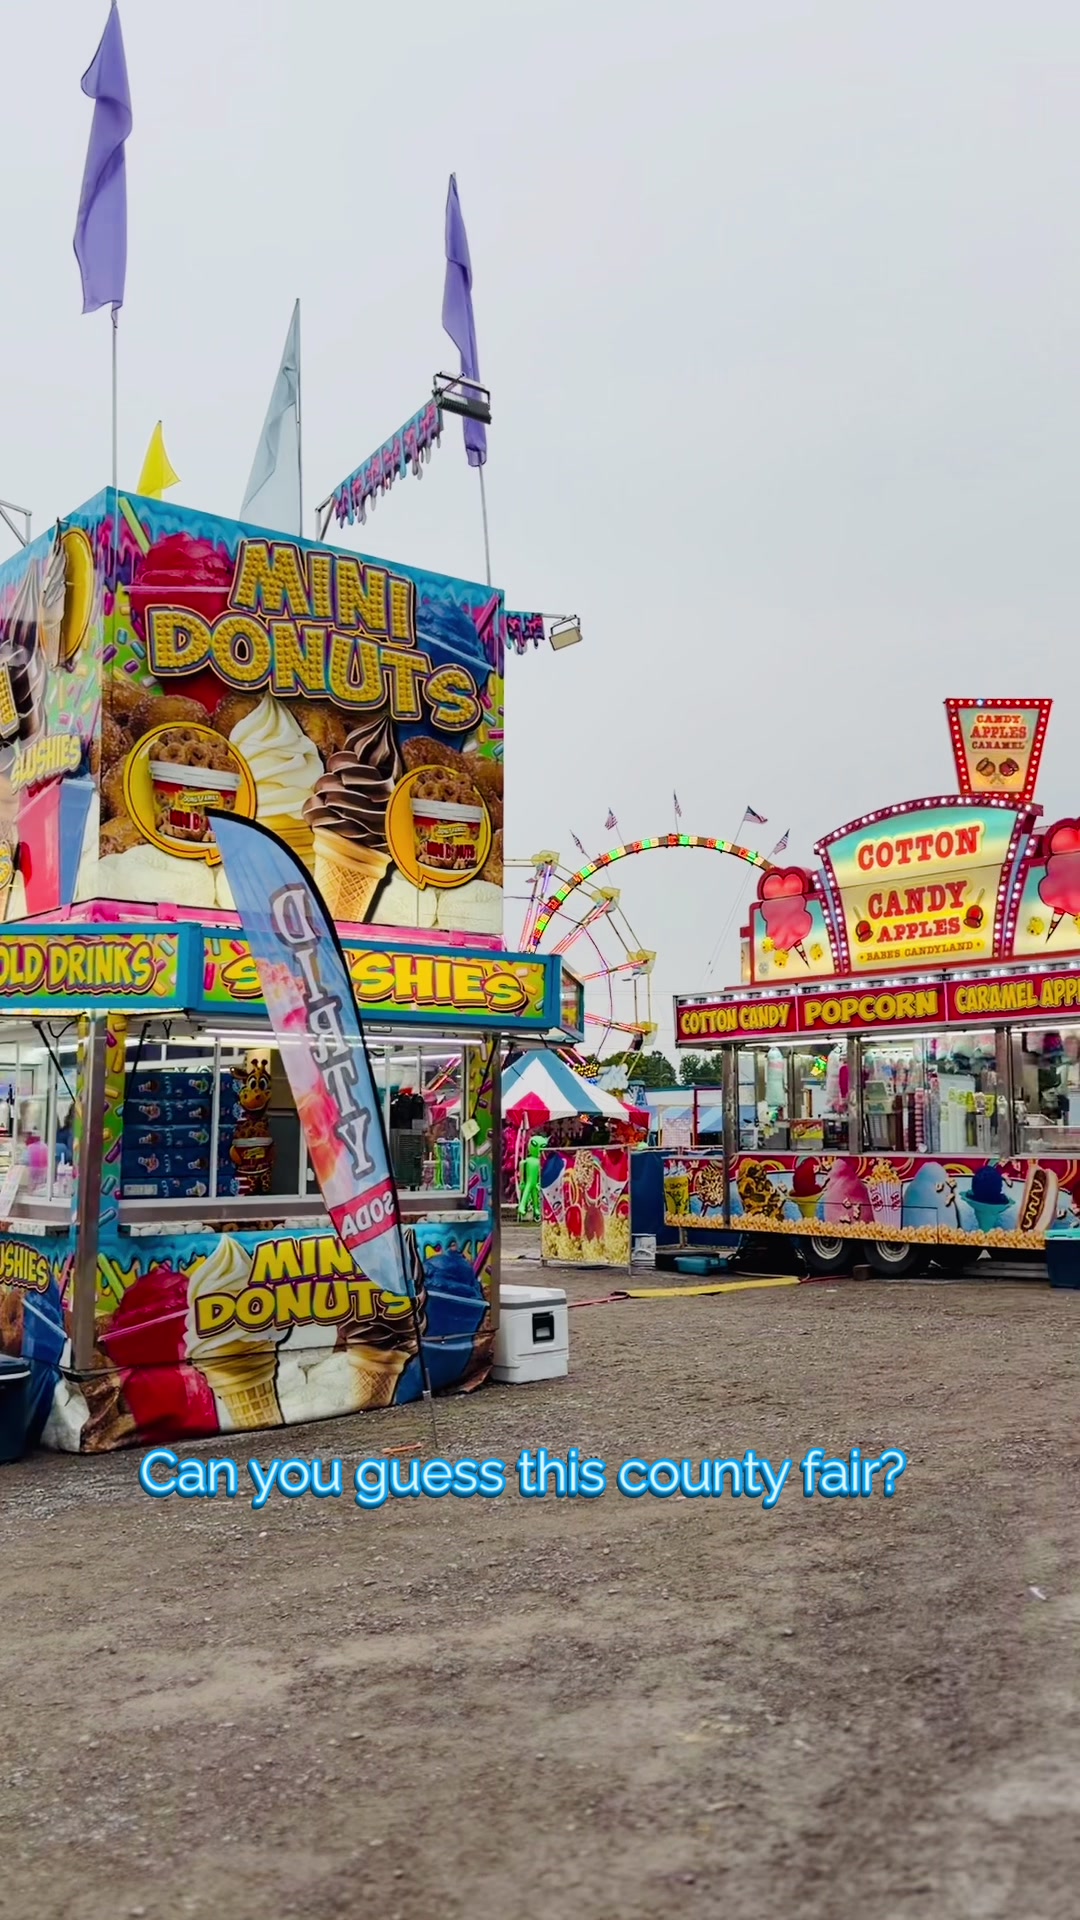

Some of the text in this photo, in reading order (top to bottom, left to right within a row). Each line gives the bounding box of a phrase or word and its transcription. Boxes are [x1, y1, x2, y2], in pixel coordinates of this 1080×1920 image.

[230, 540, 414, 643] MINI
[149, 607, 480, 728] DONUTS
[970, 725, 1027, 739] APPLES
[976, 714, 1021, 724] CANDY
[11, 735, 82, 791] SLUSHIES
[971, 740, 1025, 750] CARAMEL
[858, 826, 980, 871] COTTON
[868, 881, 967, 919] CANDY
[876, 917, 960, 943] APPLES
[904, 941, 974, 957] CANDYLAND
[49, 942, 154, 989] DRINKS
[221, 950, 527, 1011] SSHIES
[804, 990, 938, 1025] POPCORN
[956, 981, 1038, 1013] CARAMEL
[680, 1002, 789, 1035] COTTON CANDY
[250, 1236, 367, 1283] MIN
[197, 1281, 412, 1333] DONUTS
